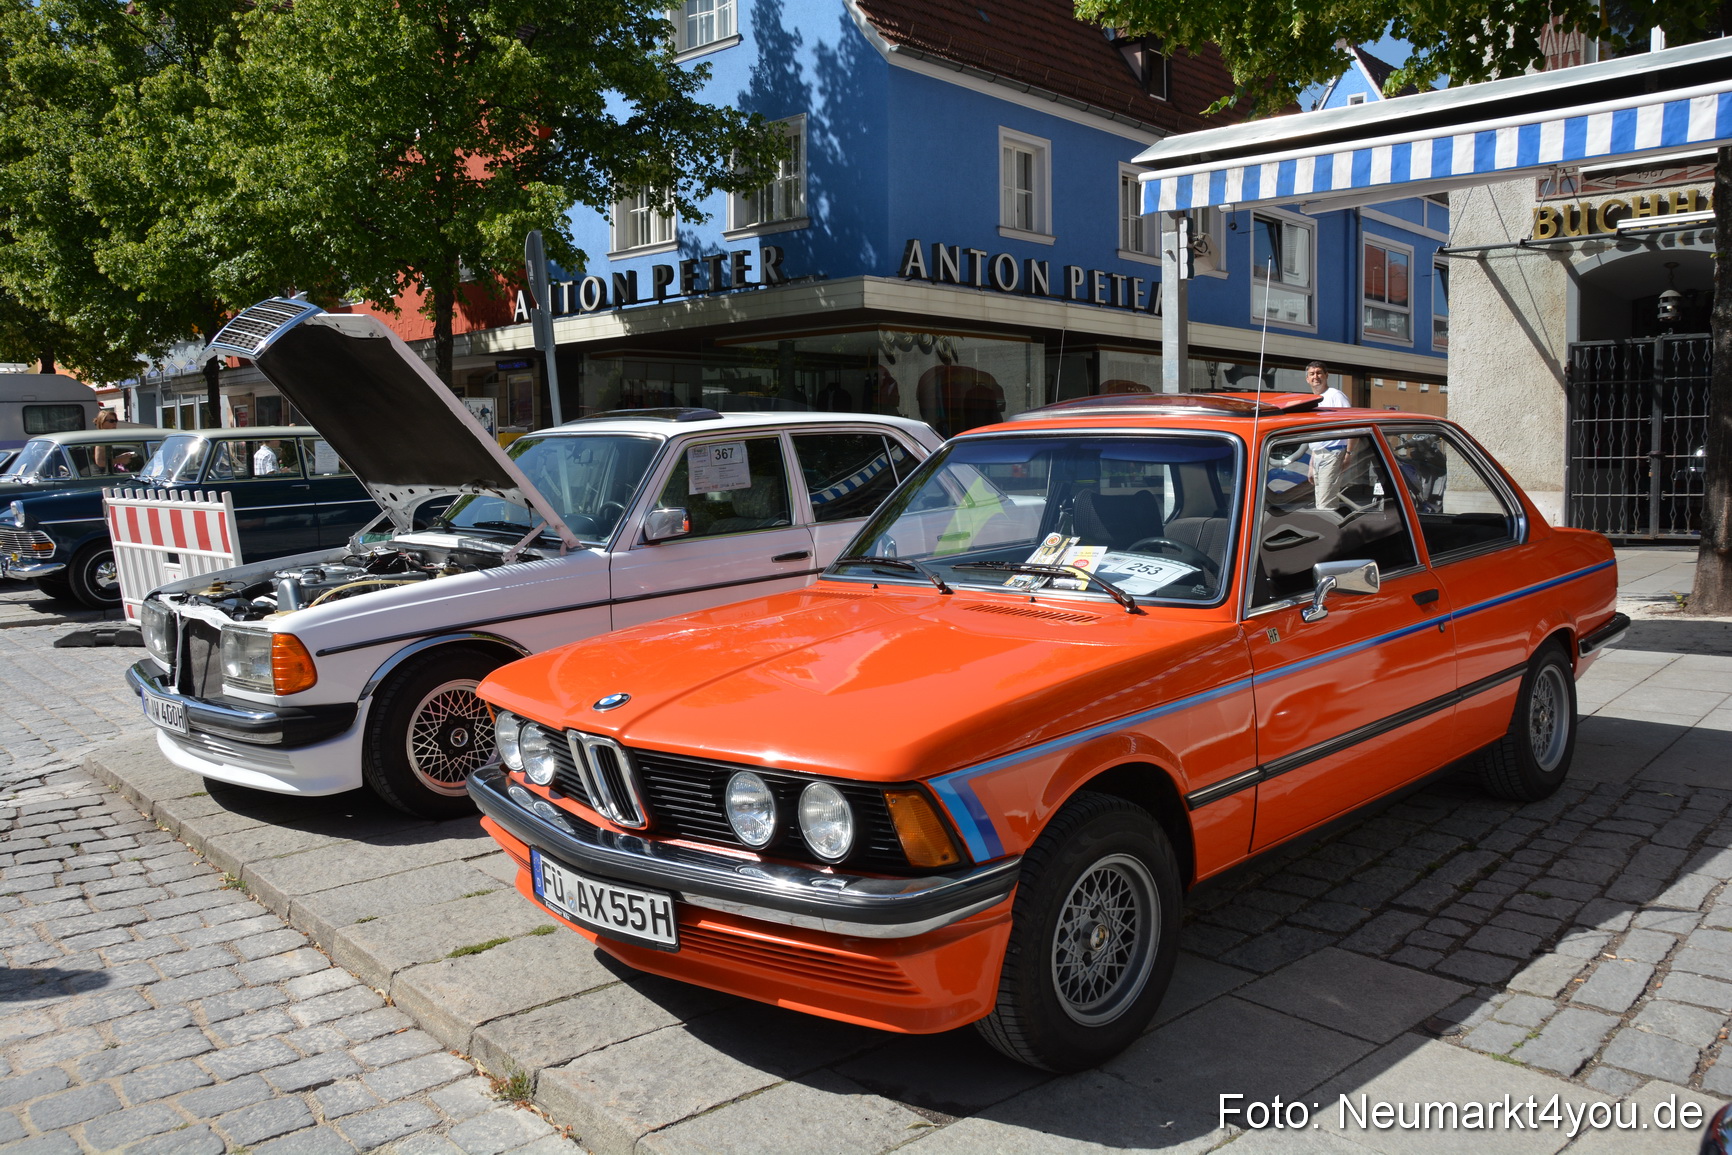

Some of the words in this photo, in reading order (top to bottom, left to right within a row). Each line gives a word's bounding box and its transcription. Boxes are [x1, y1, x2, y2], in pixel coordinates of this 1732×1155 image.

[513, 269, 637, 322] ATON
[652, 245, 786, 300] PETER
[900, 239, 1050, 296] ANTON
[715, 447, 734, 461] 367
[1126, 562, 1164, 576] 253
[541, 859, 566, 905] FÜ
